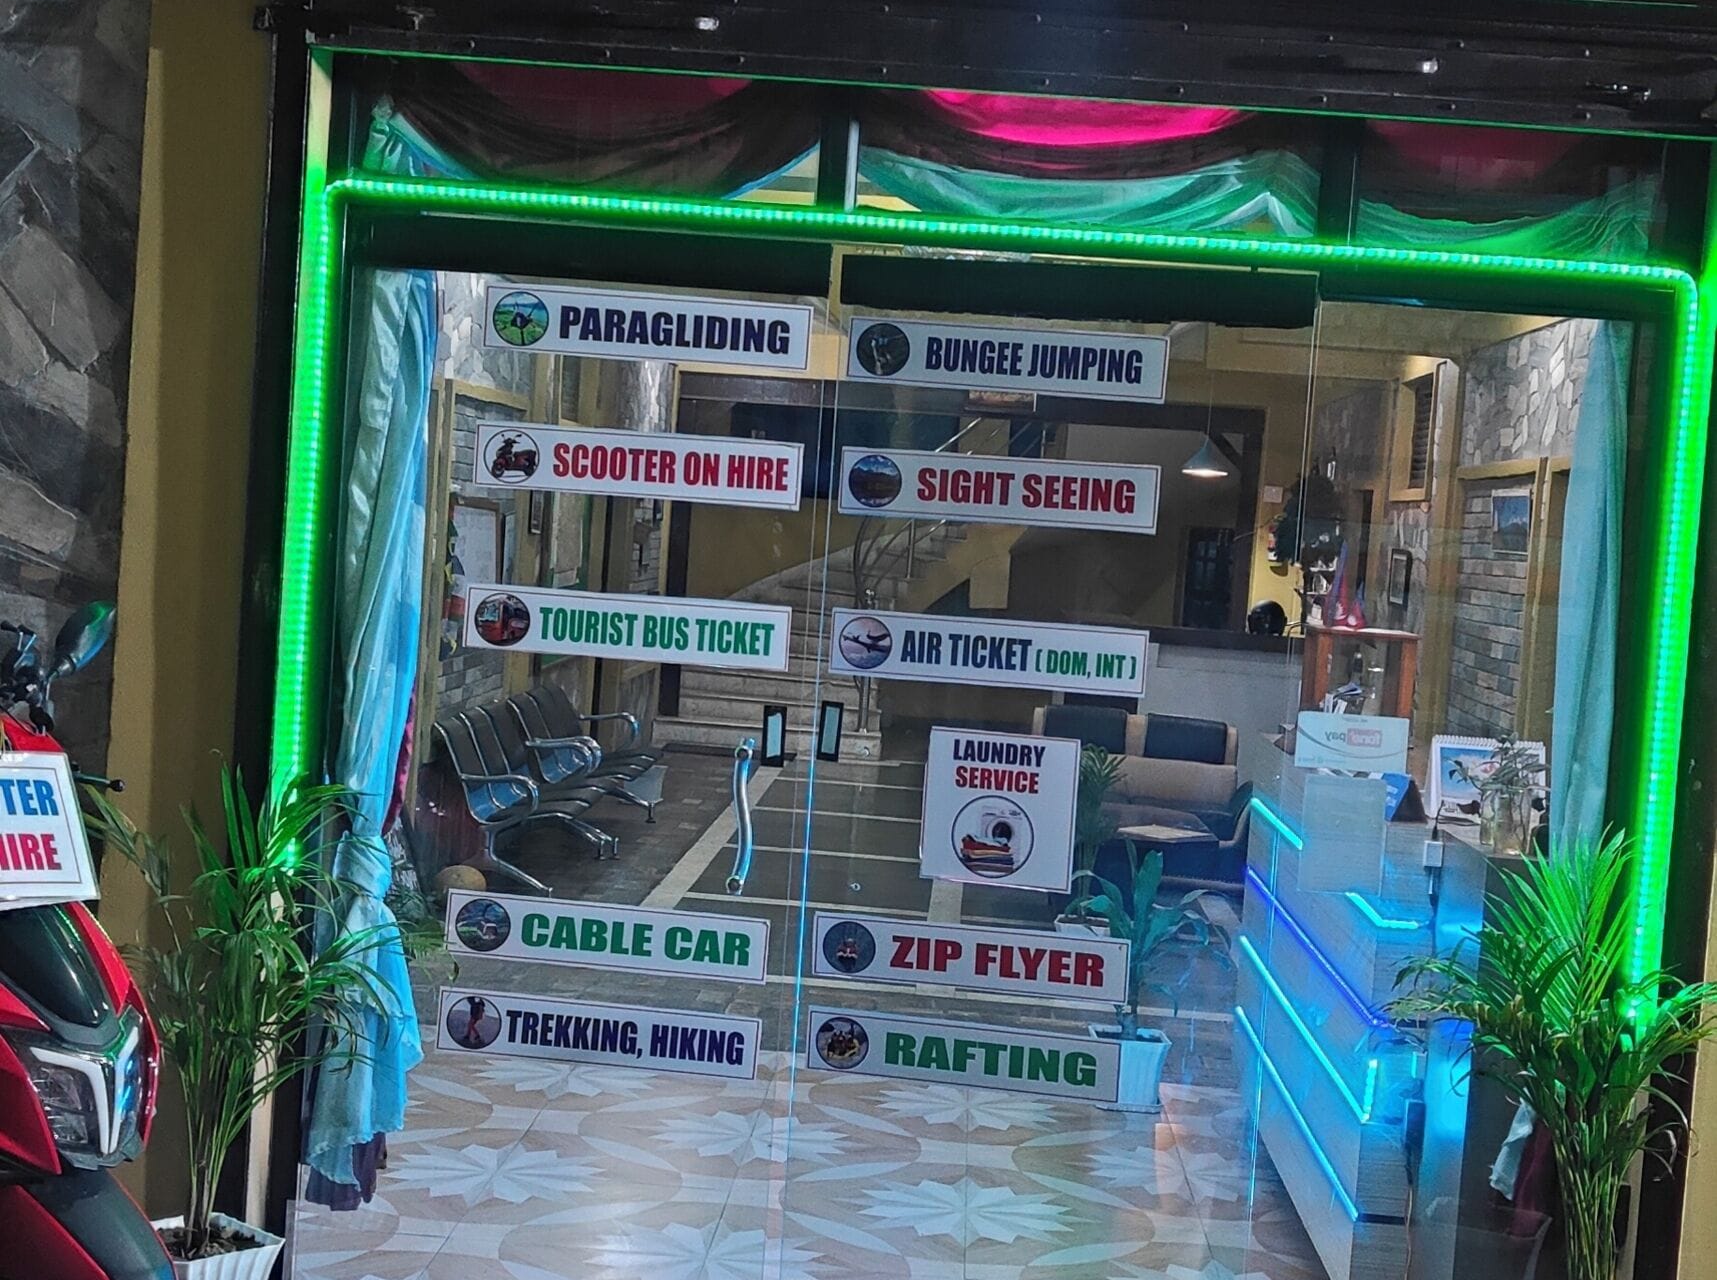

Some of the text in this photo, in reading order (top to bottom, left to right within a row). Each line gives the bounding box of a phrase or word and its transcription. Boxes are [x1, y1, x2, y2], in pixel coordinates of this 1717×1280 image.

[559, 305, 790, 355] PARAGLIDING
[925, 336, 1143, 385] BUNGEE JUMPING
[553, 442, 789, 492] SCOOTER ON HIRE
[917, 468, 1136, 515] SIGHT SEEING
[540, 607, 776, 658] TOURIST BUS TICKET
[901, 630, 942, 664] AIR
[949, 634, 1032, 672] TICKET
[1045, 651, 1090, 679] DOM,
[1096, 653, 1126, 678] INT
[953, 739, 1045, 767] LAUNDRY
[955, 766, 1039, 794] SERVICE
[521, 912, 750, 966] CABLE CAR
[889, 935, 1104, 988] ZIP FLYER
[506, 1009, 744, 1066] TREKKING, HIKING
[884, 1034, 1096, 1088] RAFTING
